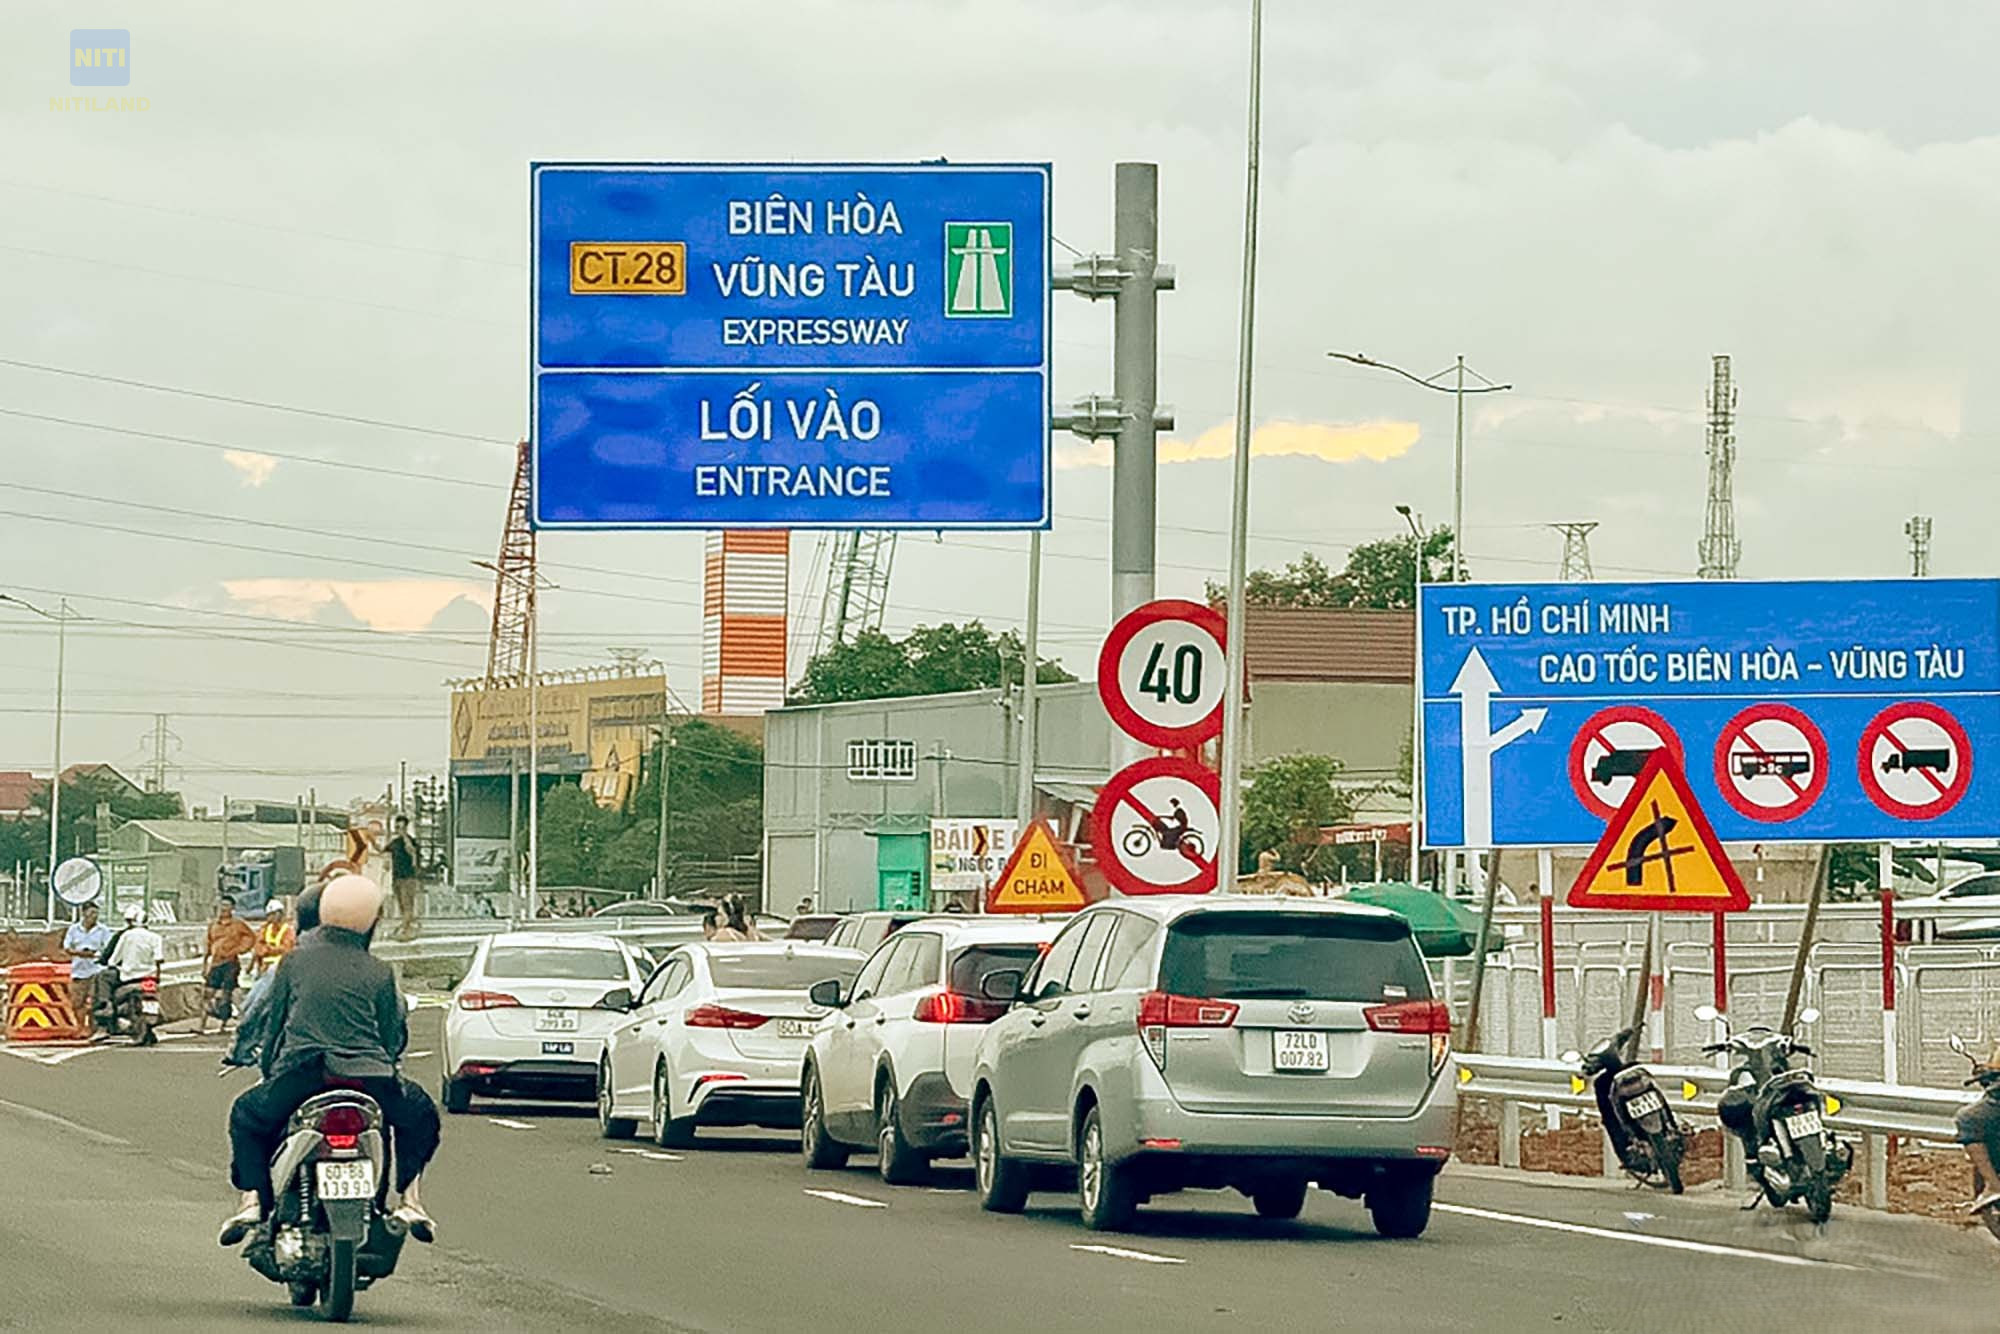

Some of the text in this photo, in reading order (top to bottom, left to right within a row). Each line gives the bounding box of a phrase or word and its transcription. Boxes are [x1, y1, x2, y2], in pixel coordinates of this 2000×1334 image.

[728, 192, 902, 234] BIÊN HÒA
[579, 252, 677, 285] CT.28
[713, 255, 914, 297] VŨNG TÀU
[723, 319, 909, 345] EXPRESSWAY
[700, 383, 880, 440] LỐI VÀO
[696, 466, 891, 496] ENTRANCE
[1442, 596, 1669, 635] TP. HỒ CHÍ MINH
[1139, 642, 1202, 704] 40
[1540, 654, 1596, 683] CAO
[1604, 645, 1658, 683] TỐC
[1668, 648, 1731, 682] BIÊN
[1741, 645, 1799, 681] HÒA
[1829, 645, 1907, 679] VŨNG
[1914, 643, 1964, 679] TÀU
[1030, 852, 1047, 869] ĐI
